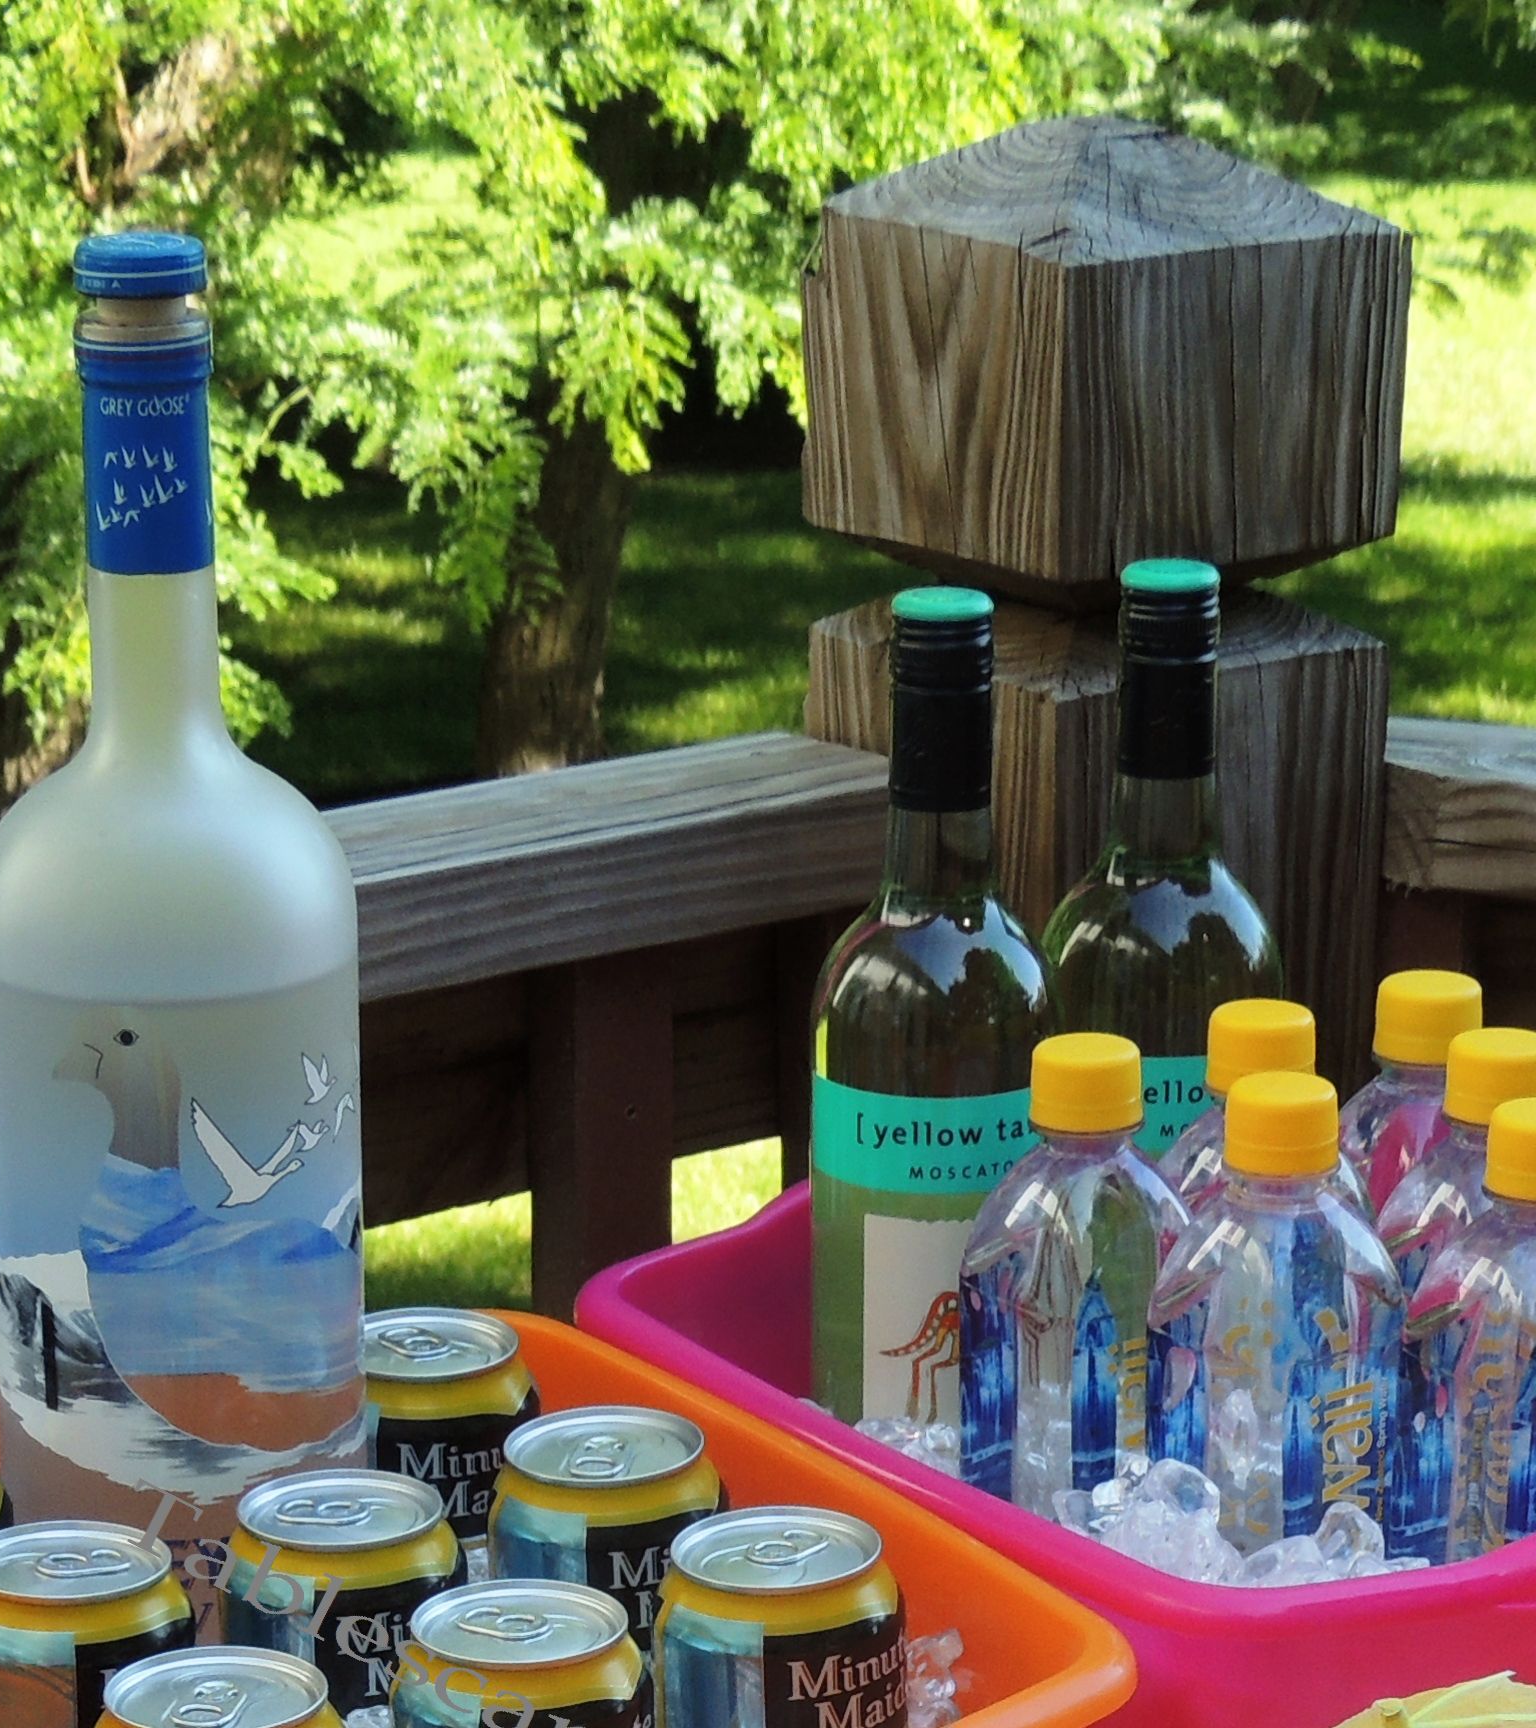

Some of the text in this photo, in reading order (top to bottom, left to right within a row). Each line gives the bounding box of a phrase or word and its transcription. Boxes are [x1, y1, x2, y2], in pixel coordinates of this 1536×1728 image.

[100, 394, 185, 416] GREY GOOSE
[1144, 1079, 1205, 1104] ello
[998, 1118, 1032, 1142] ta
[786, 1627, 906, 1701] Minut
